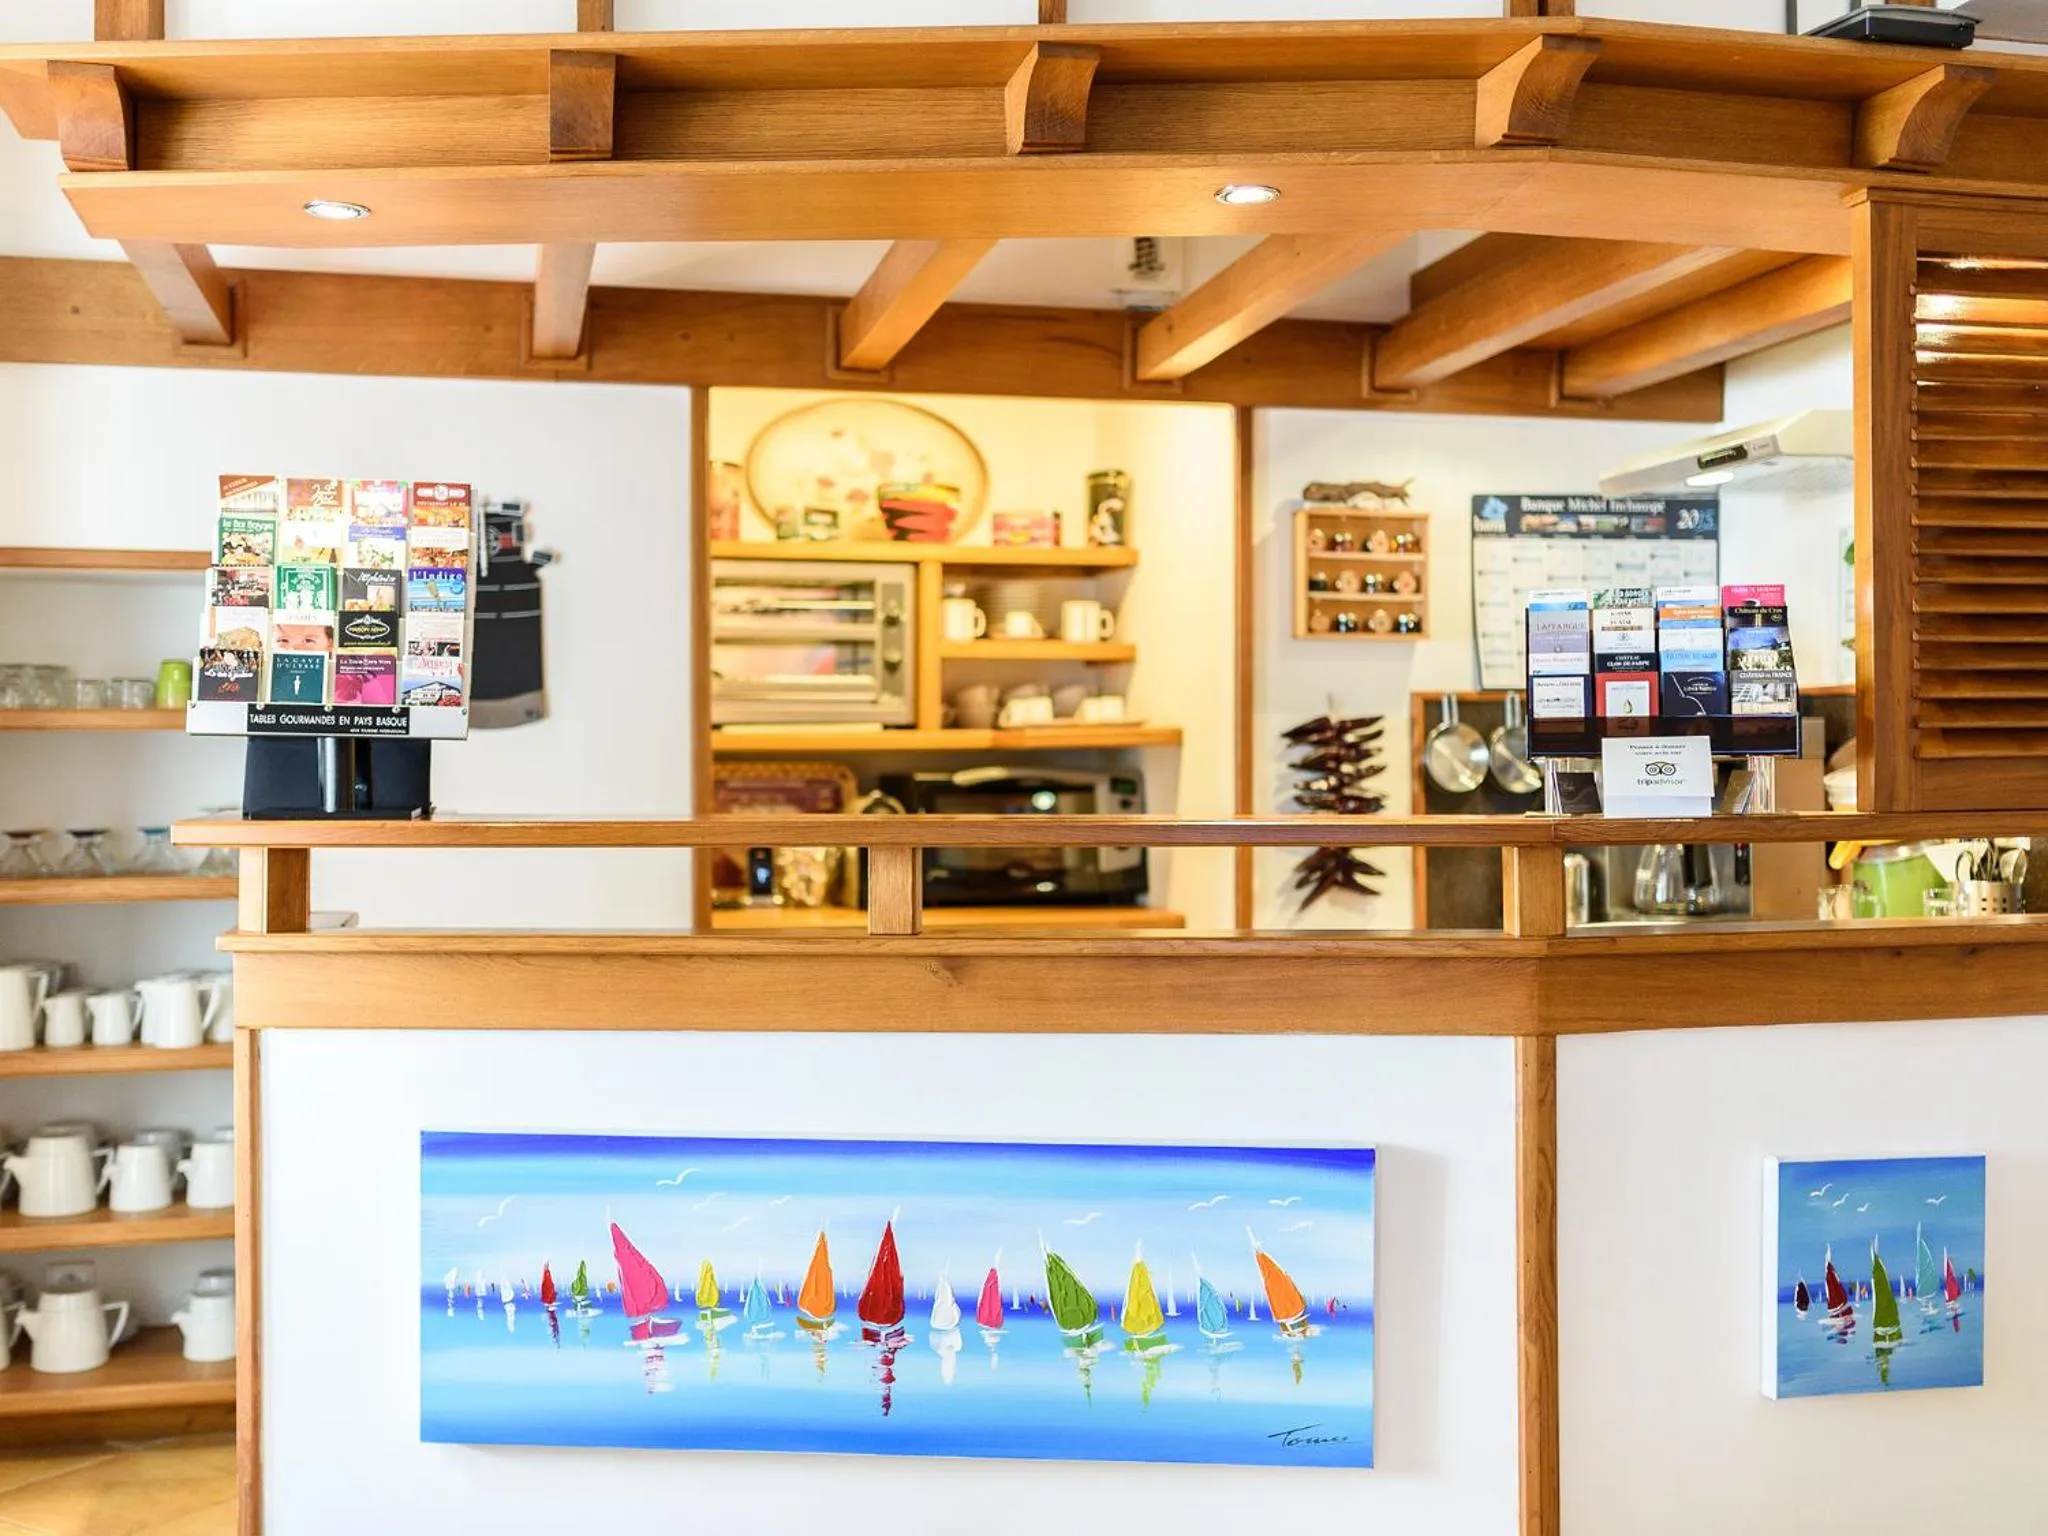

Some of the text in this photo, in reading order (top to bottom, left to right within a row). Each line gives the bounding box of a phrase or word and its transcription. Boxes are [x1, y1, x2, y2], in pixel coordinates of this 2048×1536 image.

[1520, 497, 1565, 514] Banque
[1568, 497, 1606, 512] Michel
[250, 713, 408, 727] TABLES GOURMANDES EN PAYS BASQUE
[1636, 778, 1684, 787] tripadvisor
